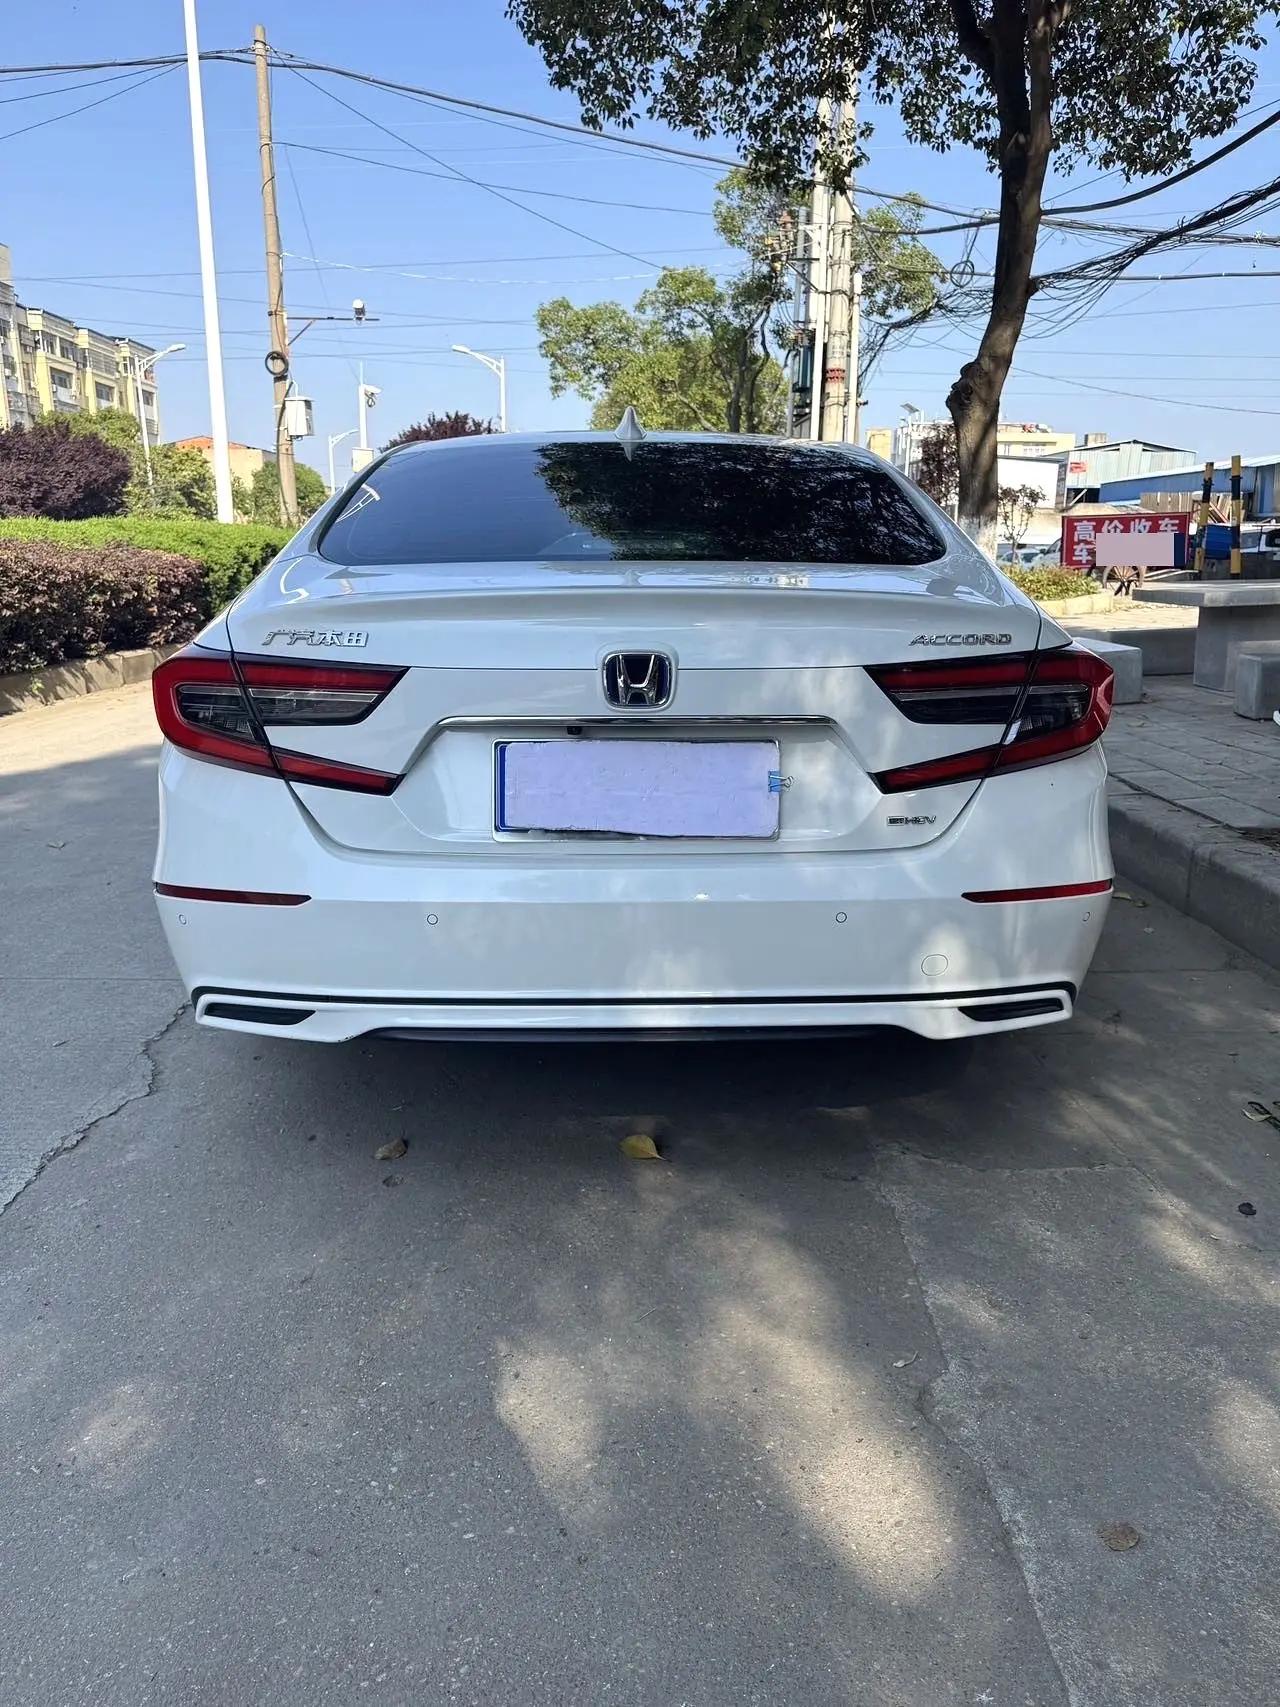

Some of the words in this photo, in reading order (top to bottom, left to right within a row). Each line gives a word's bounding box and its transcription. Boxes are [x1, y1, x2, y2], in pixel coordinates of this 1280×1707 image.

[262, 630, 369, 648] 广汽本田
[908, 633, 1012, 646] ACCORD
